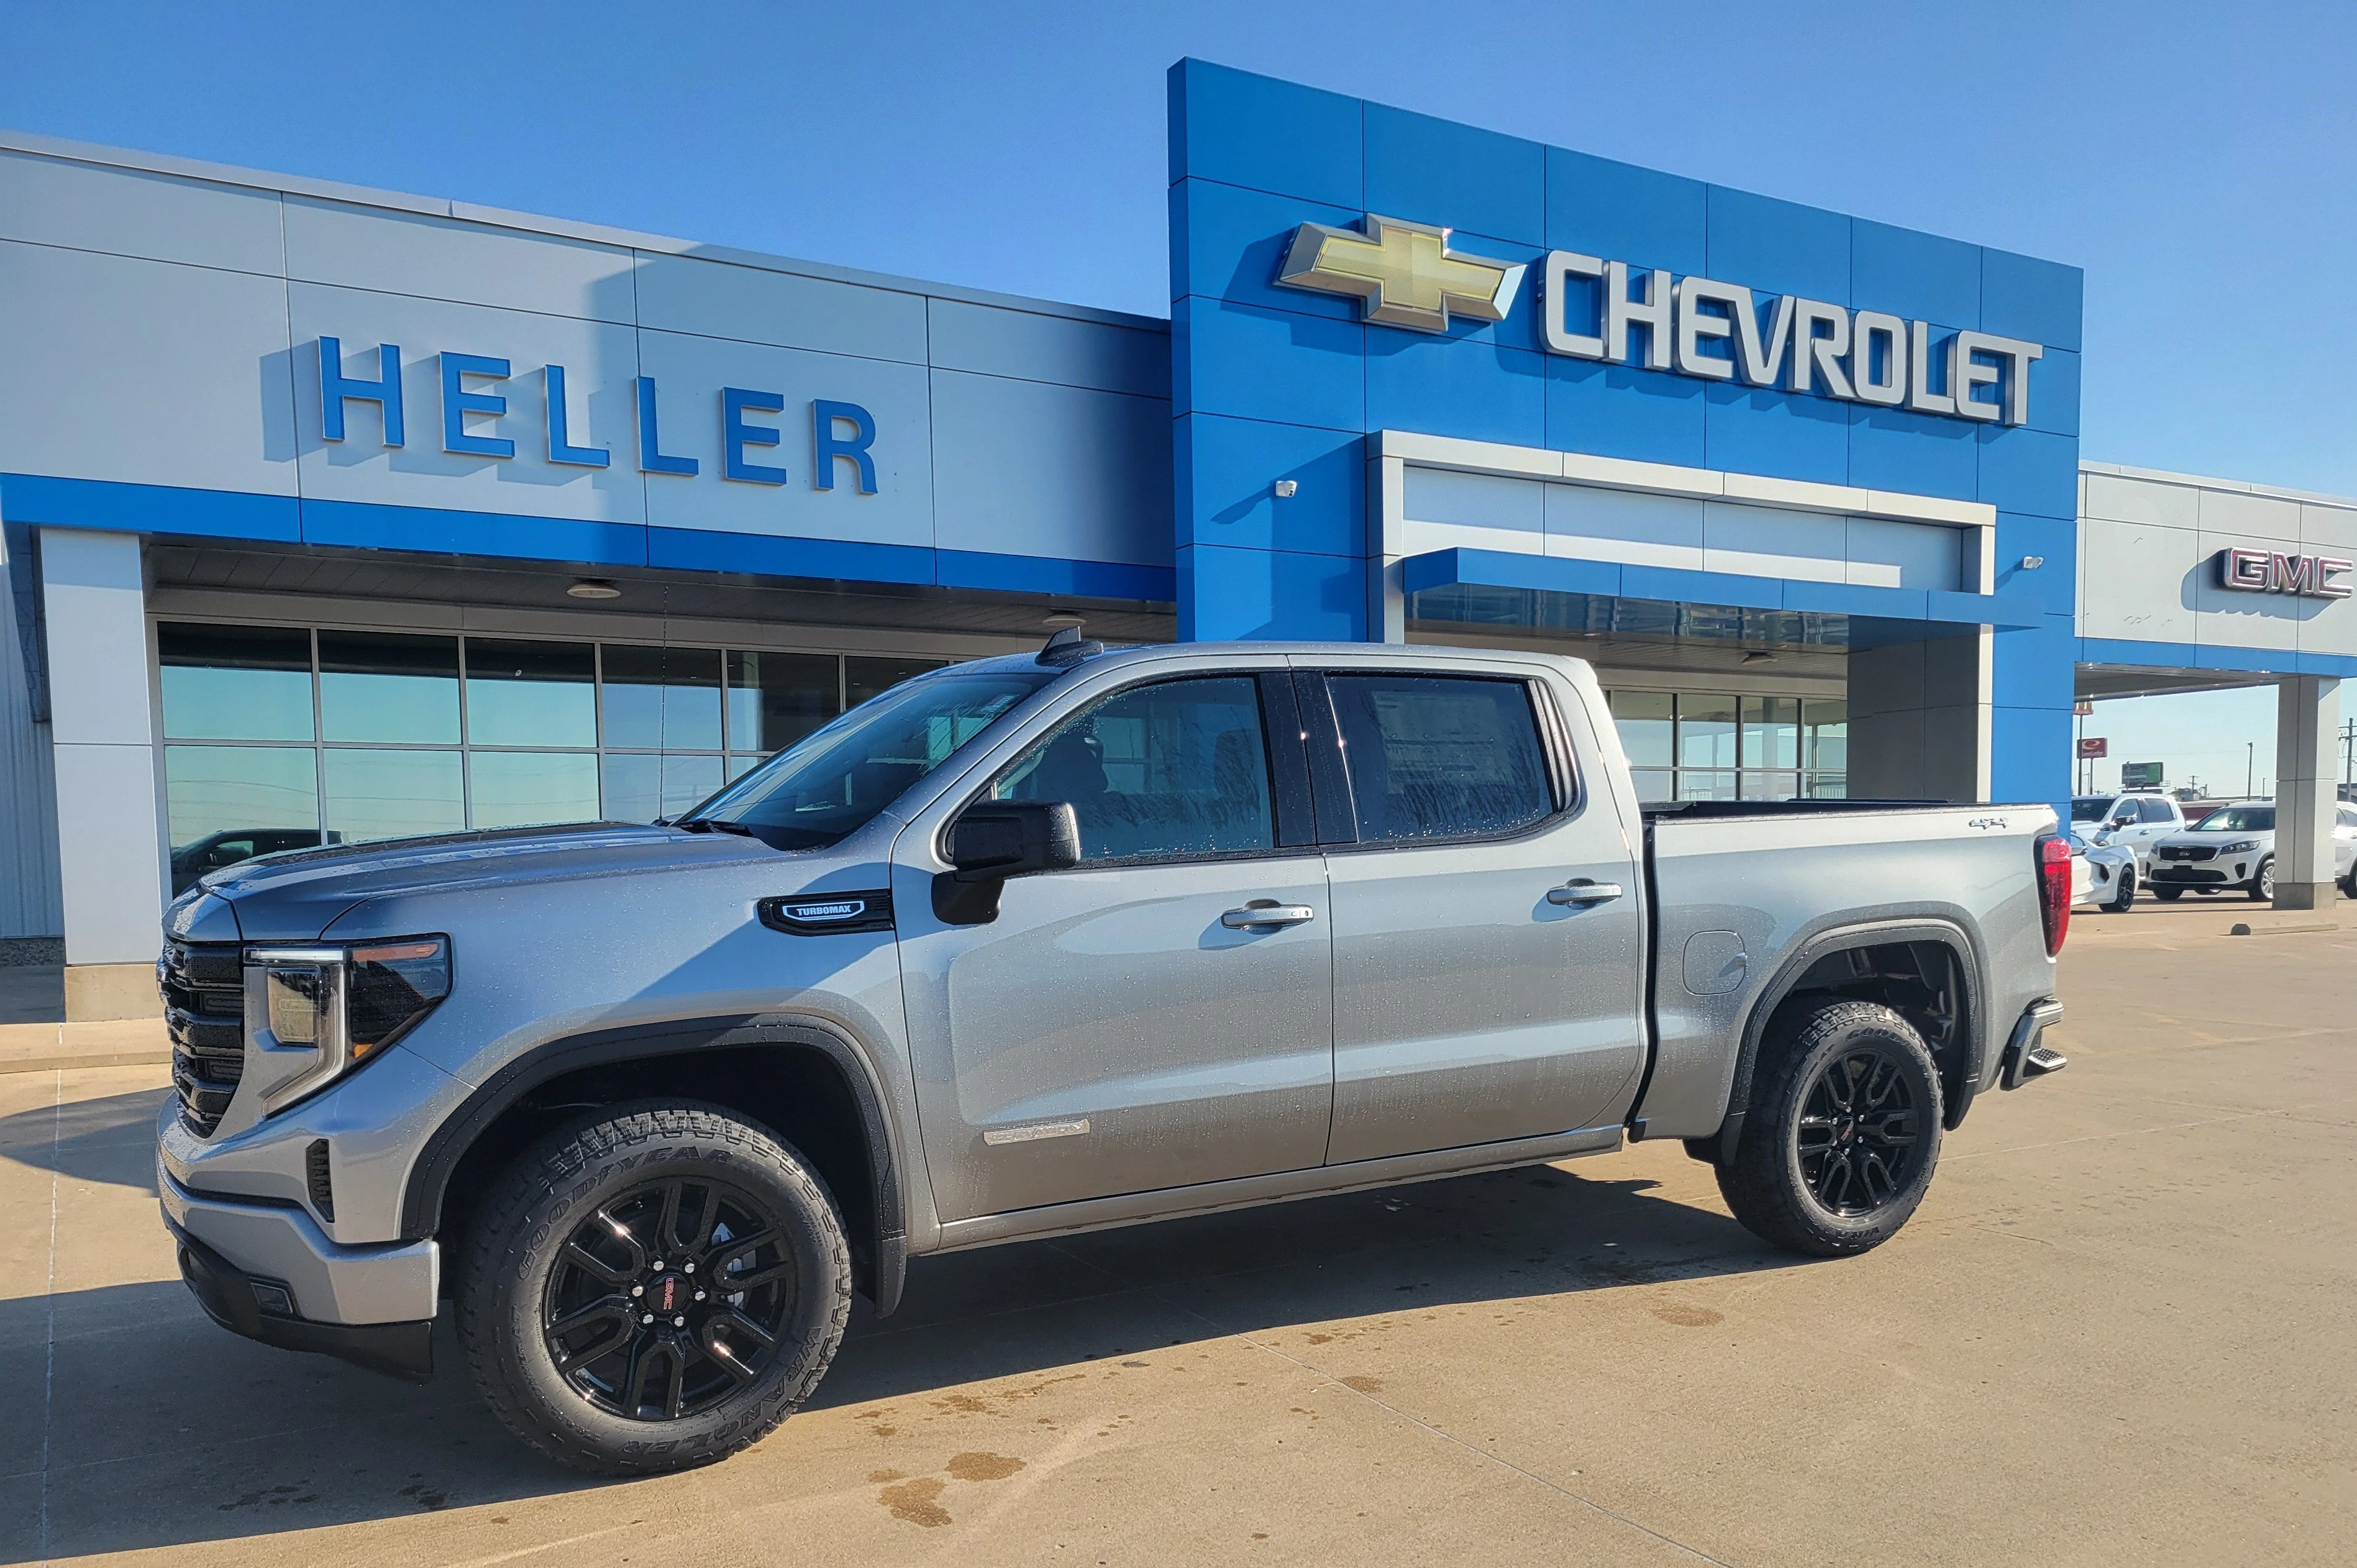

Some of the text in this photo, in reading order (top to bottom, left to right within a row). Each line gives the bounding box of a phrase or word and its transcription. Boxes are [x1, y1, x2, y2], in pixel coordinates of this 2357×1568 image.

[1539, 249, 2043, 426] CHEVROLET
[317, 335, 878, 496] HELLER
[2225, 547, 2353, 599] GMC
[796, 905, 852, 916] TURBOMAX
[518, 1146, 734, 1280] GOODYEAR
[663, 1277, 674, 1310] GMC
[622, 1327, 822, 1454] WRANGLER
